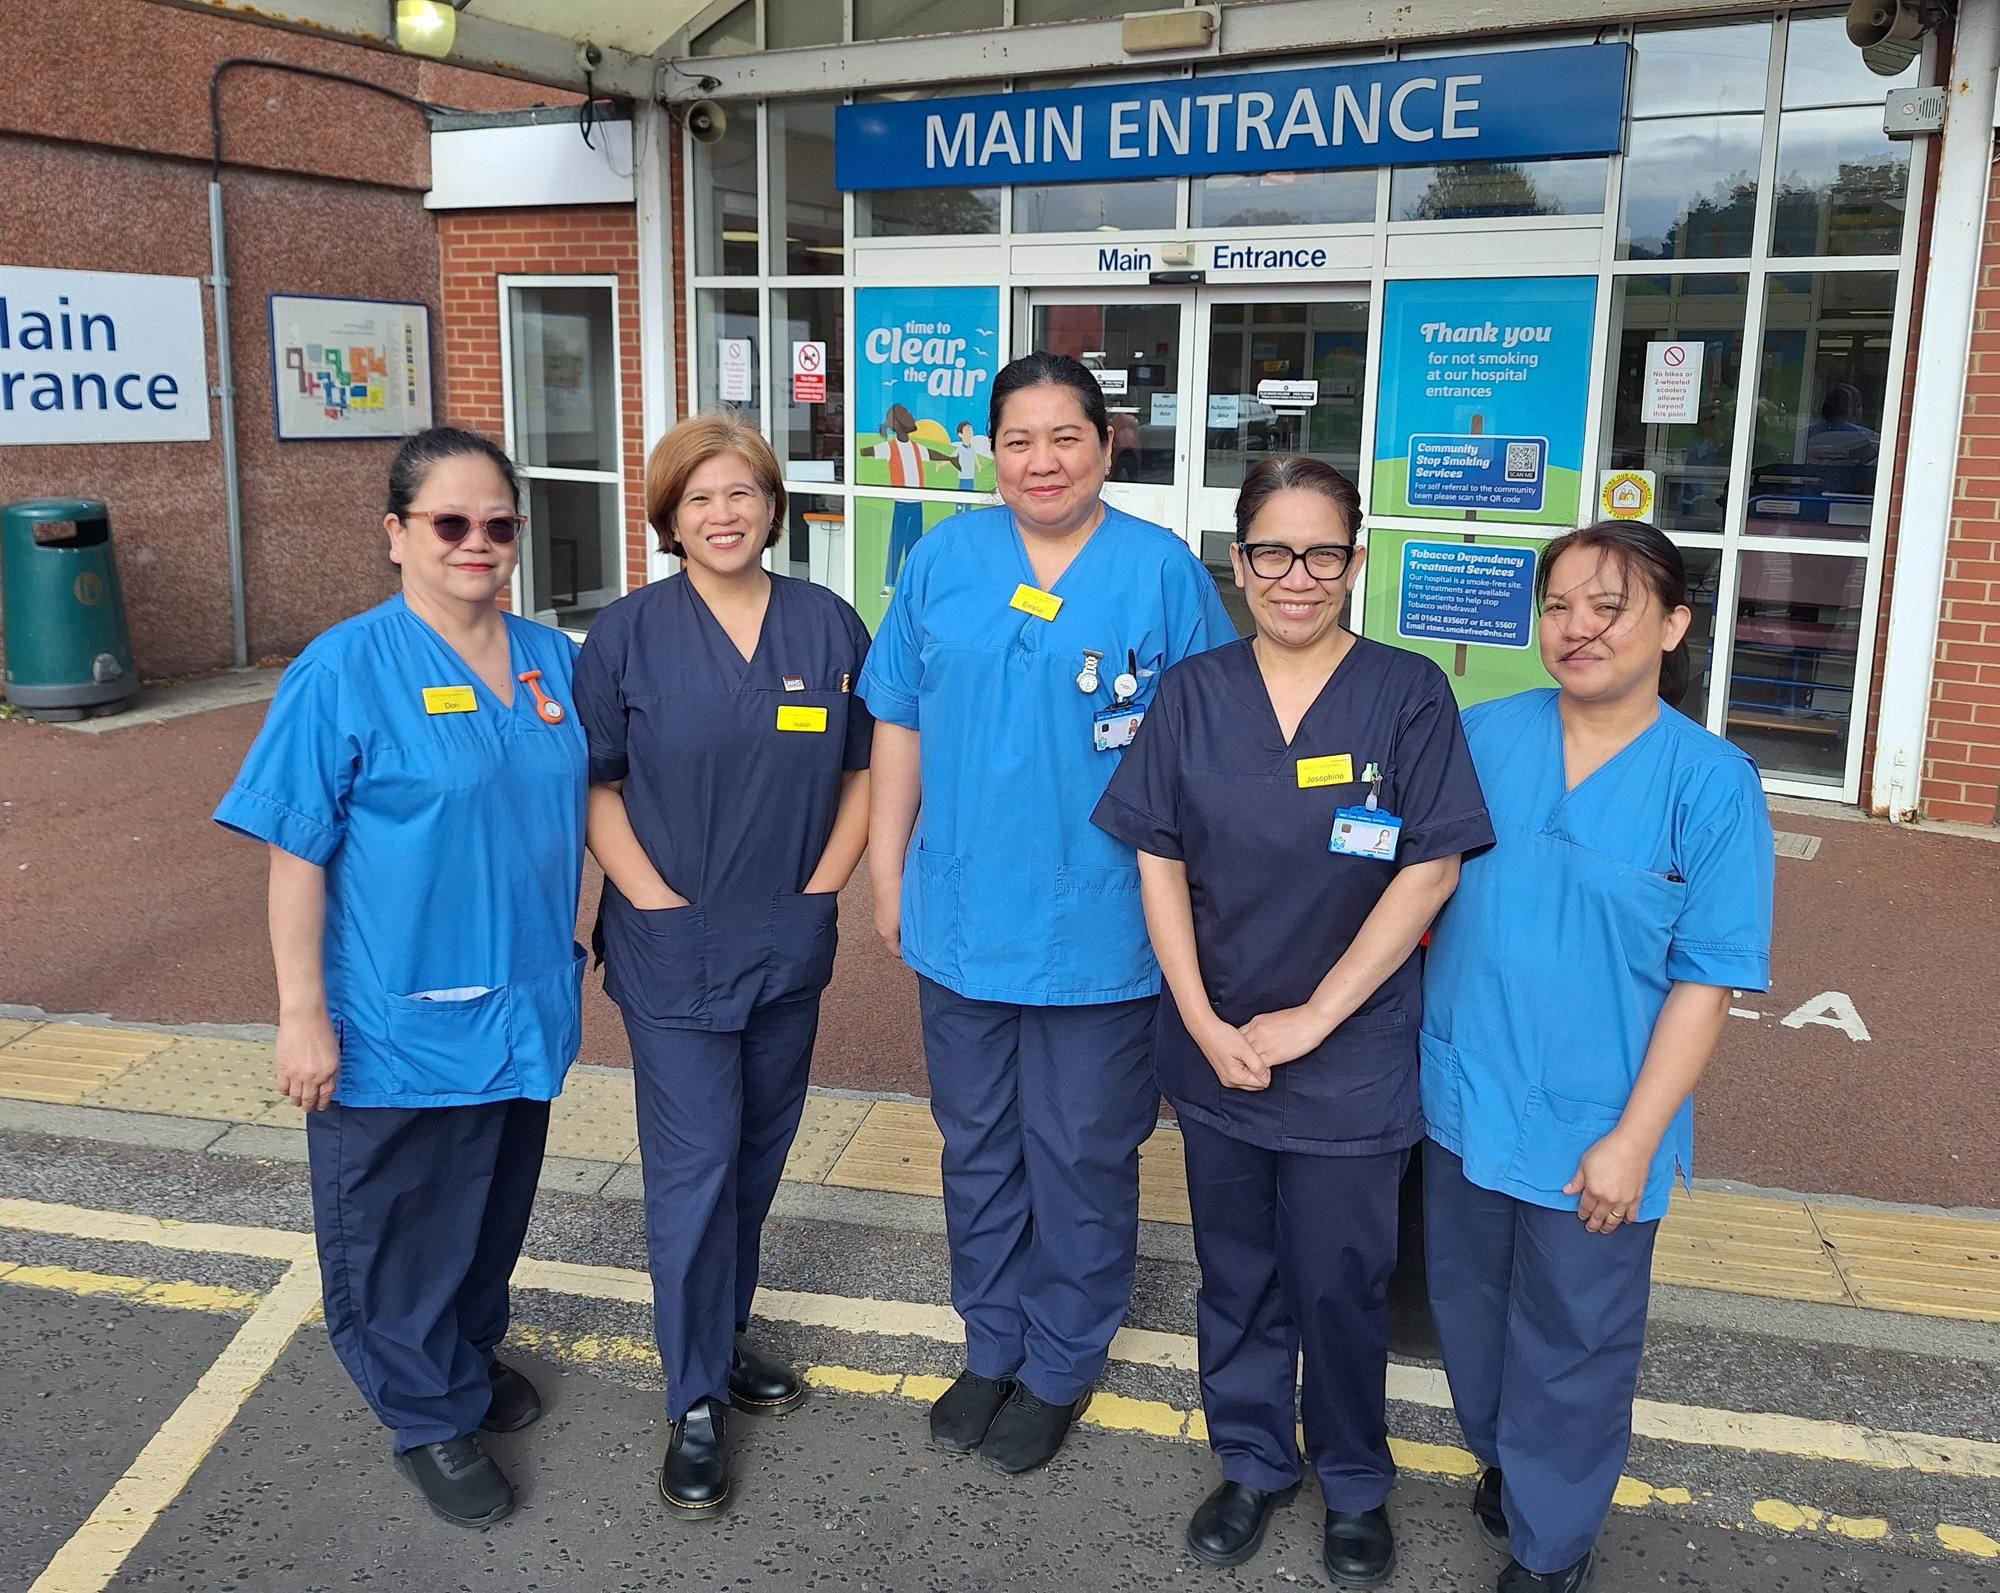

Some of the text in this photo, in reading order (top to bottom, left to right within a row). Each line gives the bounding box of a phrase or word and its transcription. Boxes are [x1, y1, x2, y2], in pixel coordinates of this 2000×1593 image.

[925, 73, 1483, 170] MAIN ENTRANCE
[1098, 245, 1327, 273] Main Entrance
[905, 320, 951, 335] time to
[1420, 321, 1552, 348] Thank you
[865, 327, 967, 365] Clear
[1428, 352, 1539, 368] for not smoking
[903, 357, 988, 397] the air
[1426, 368, 1528, 384] at our hospital
[1425, 386, 1492, 397] entrances
[1417, 443, 1479, 456] Community
[1416, 455, 1490, 469] Stop Smoking
[1415, 467, 1463, 479] Services
[1415, 482, 1427, 490] For
[1442, 484, 1469, 492] referral
[1480, 485, 1492, 493] the
[1494, 487, 1536, 496] community
[1434, 492, 1457, 501] please
[1475, 494, 1488, 502] the
[1489, 495, 1501, 503] QR
[1502, 496, 1520, 504] code
[1410, 549, 1525, 568] Tobacco Dependency
[1409, 560, 1515, 577] Treatment Services
[1424, 574, 1452, 584] hospital
[1466, 579, 1507, 588] smoke-free
[1425, 585, 1463, 593] treatments
[1478, 589, 1510, 598] available
[1408, 600, 1436, 610] Tobacco
[1466, 596, 1482, 605] help
[1406, 622, 1426, 630] Email
[1420, 614, 1442, 622] 01642
[1443, 616, 1468, 625] 835607
[1495, 620, 1517, 630] 55607
